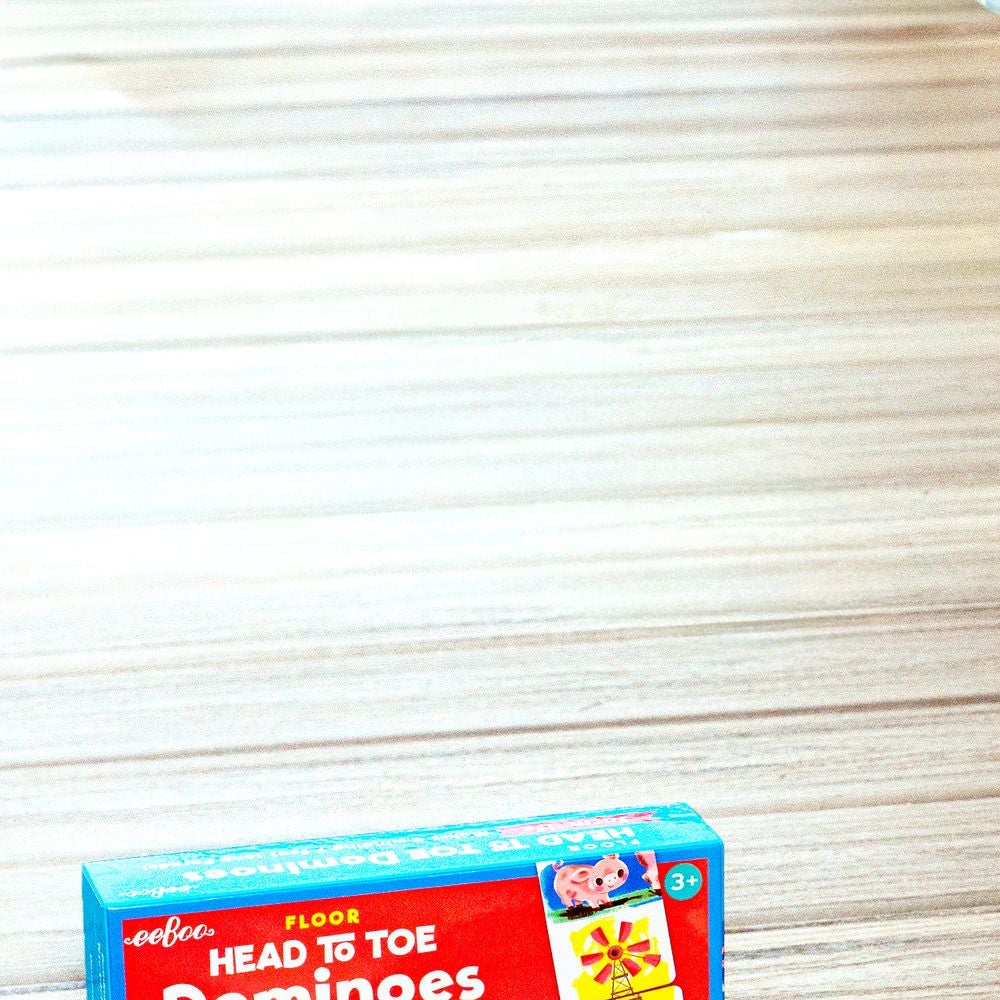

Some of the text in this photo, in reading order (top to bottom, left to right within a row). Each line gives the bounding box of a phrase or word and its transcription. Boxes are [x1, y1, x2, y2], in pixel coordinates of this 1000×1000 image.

[182, 850, 401, 882] Dominoes
[670, 872, 699, 892] 3+
[285, 908, 360, 930] FLOOR
[209, 940, 307, 976] HEAD
[364, 925, 438, 959] TOE
